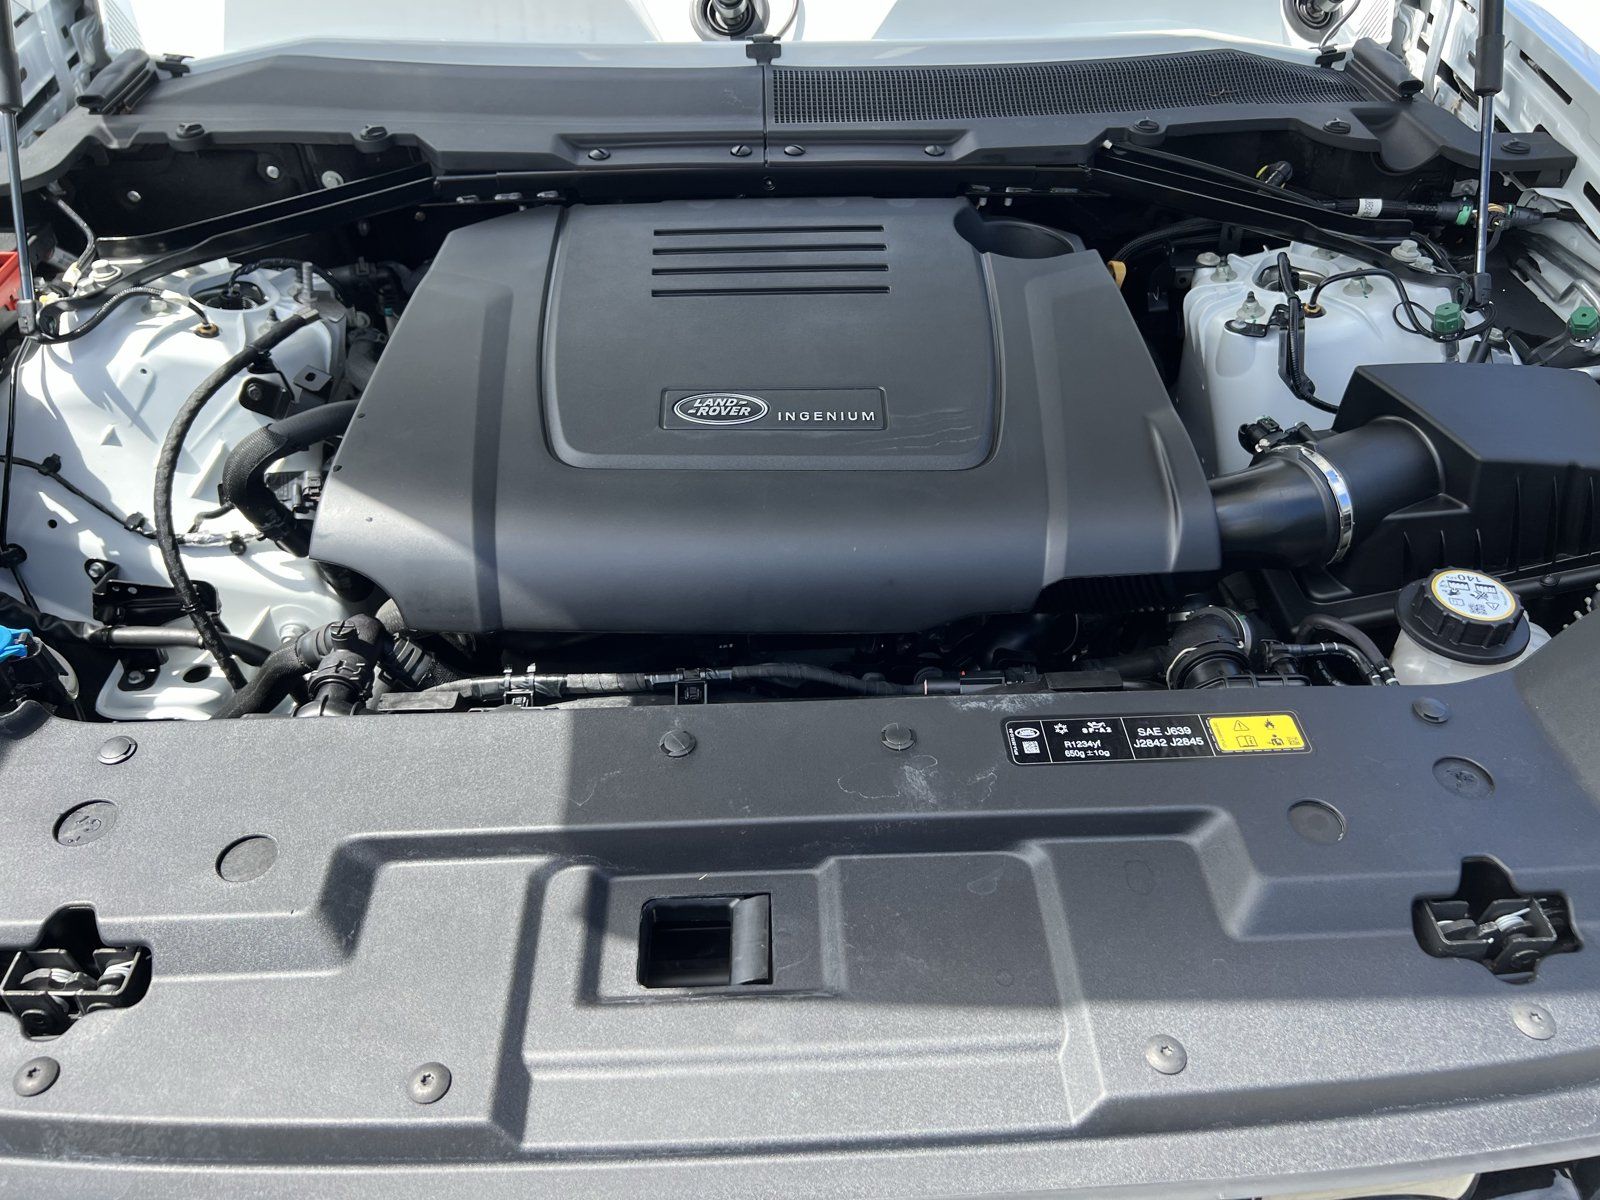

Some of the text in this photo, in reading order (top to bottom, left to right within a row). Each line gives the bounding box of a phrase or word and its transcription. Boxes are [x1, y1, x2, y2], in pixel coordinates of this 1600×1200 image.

[694, 398, 737, 407] LAND
[697, 406, 751, 416] ROVER
[778, 411, 876, 421] INGENIUM
[1137, 726, 1192, 736] SAE J639
[1064, 739, 1101, 748] R1234yf
[1133, 737, 1204, 748] J2842 J2845
[1064, 749, 1086, 758] 650g
